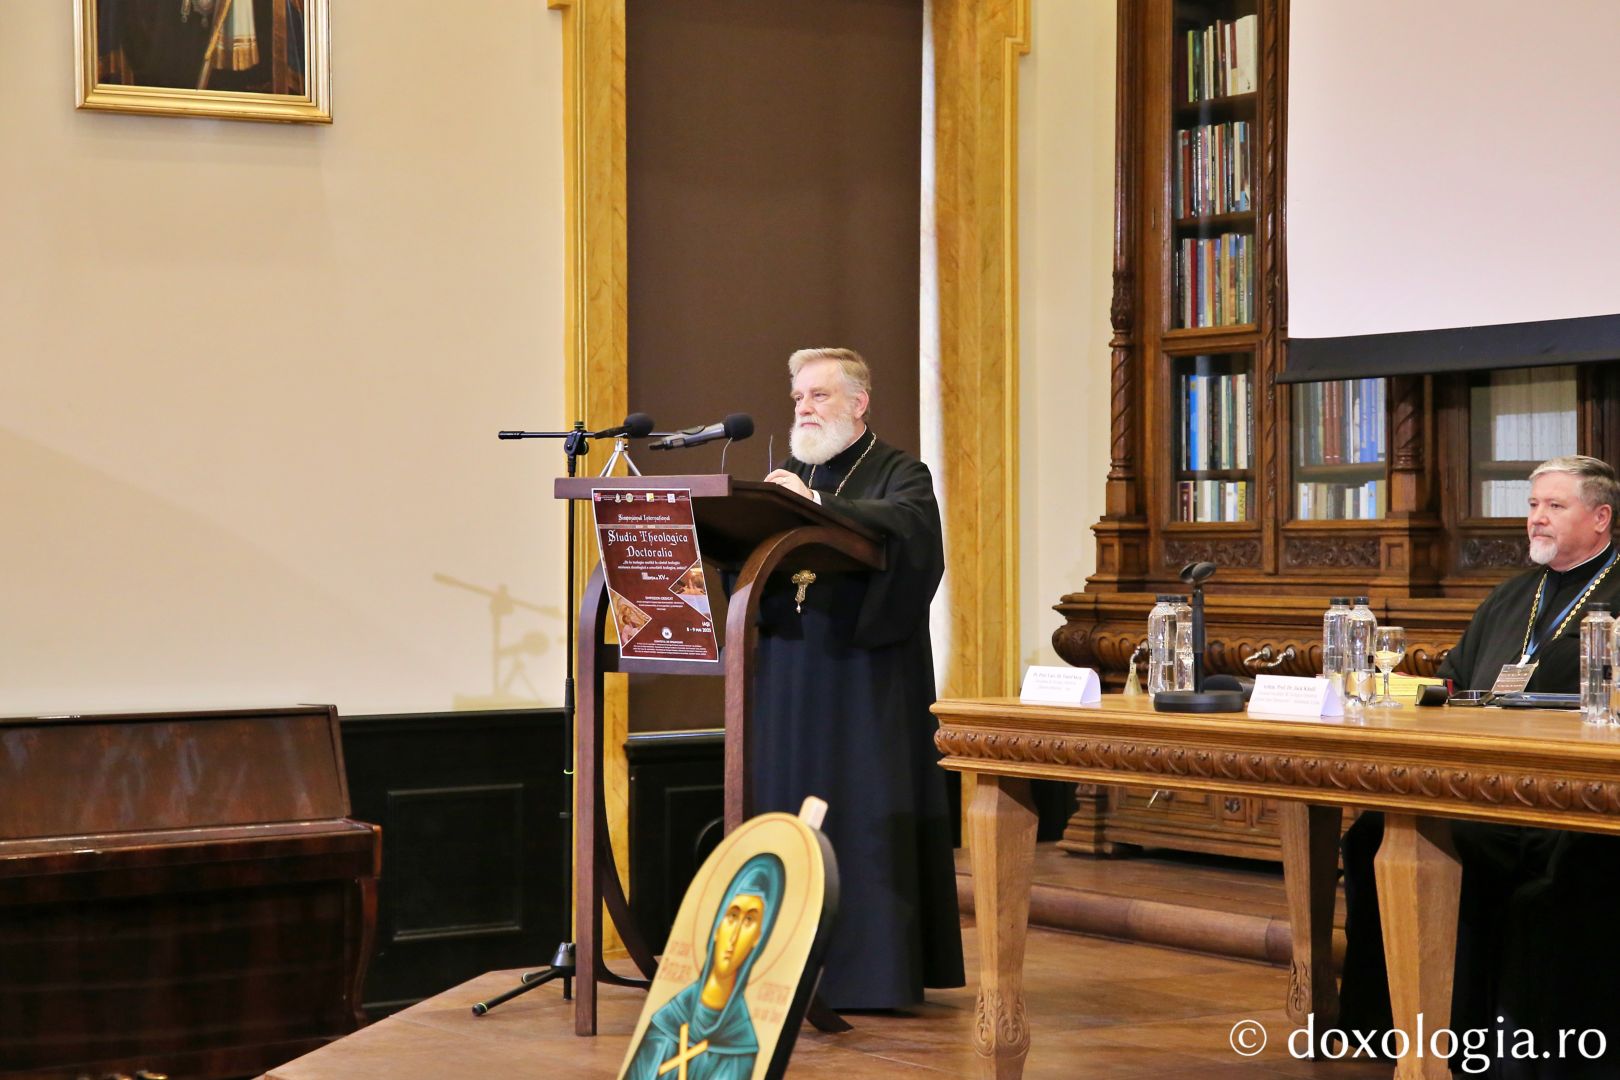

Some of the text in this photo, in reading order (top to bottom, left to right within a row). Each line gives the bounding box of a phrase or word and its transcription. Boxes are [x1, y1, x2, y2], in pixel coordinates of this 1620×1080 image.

[608, 530, 688, 546] Studia Theologica
[626, 546, 673, 557] Doctoralia
